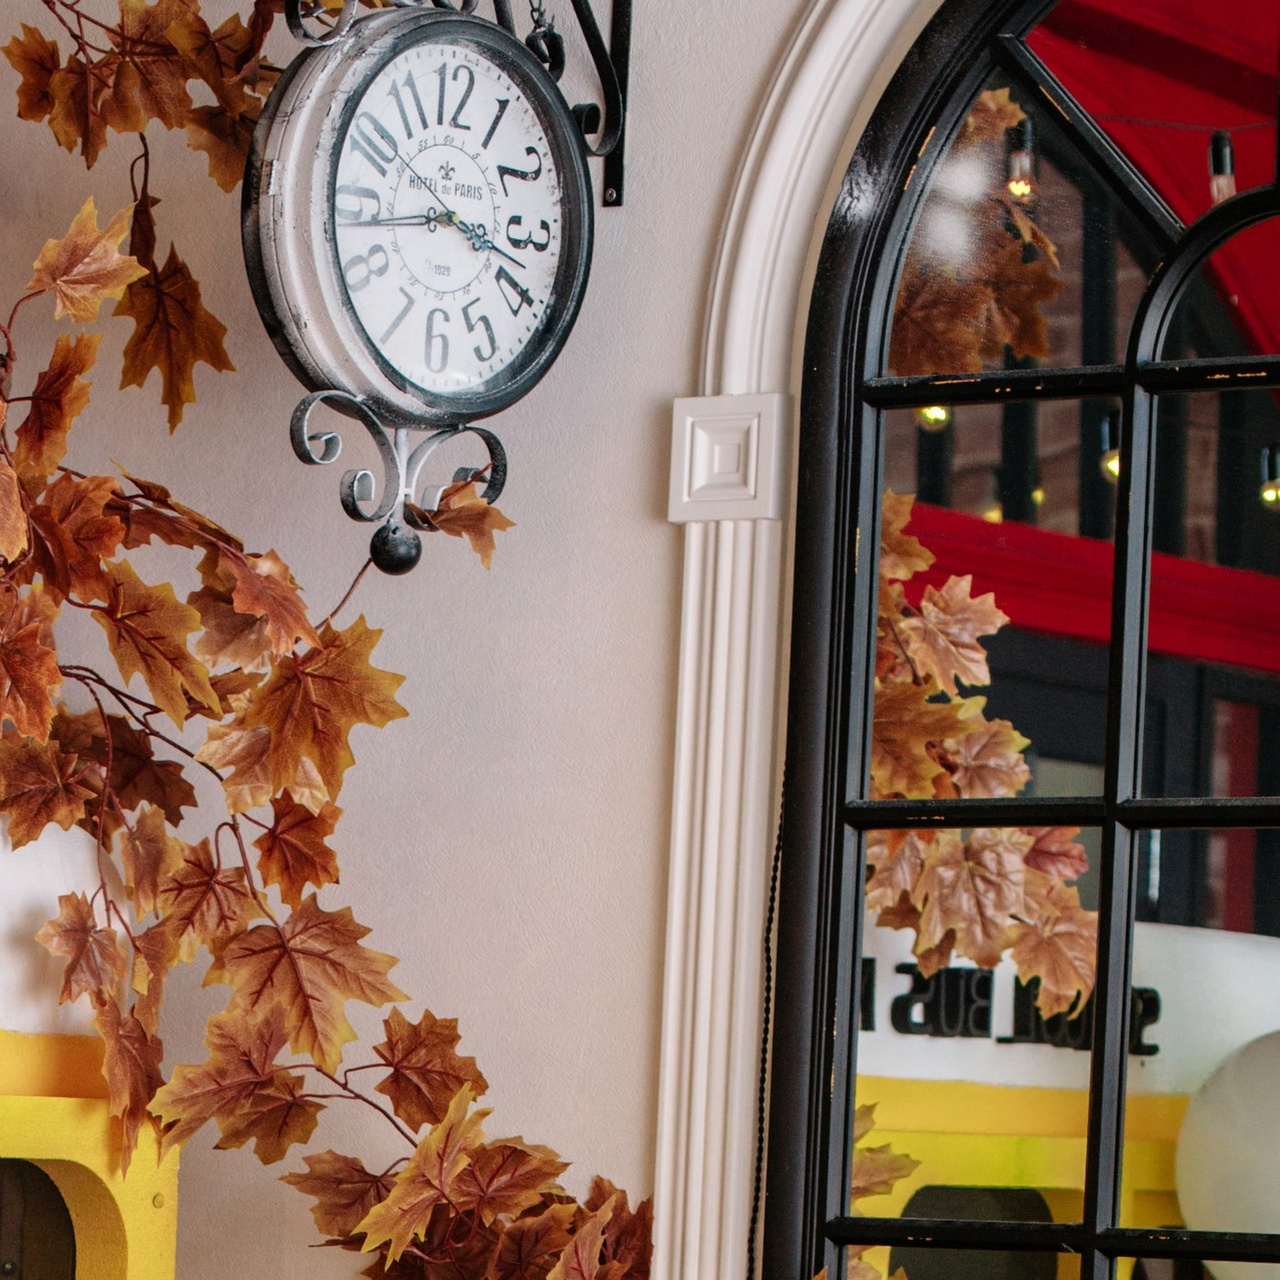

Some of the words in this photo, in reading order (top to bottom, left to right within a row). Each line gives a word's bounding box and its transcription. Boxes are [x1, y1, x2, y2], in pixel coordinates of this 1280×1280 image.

[386, 69, 428, 140] 11
[433, 61, 475, 131] 12
[349, 111, 398, 178] 10
[481, 97, 510, 150] 1
[409, 175, 438, 194] HOTEL
[454, 182, 483, 201] PARIS
[496, 146, 542, 197] 2
[335, 184, 381, 222] 9
[506, 215, 550, 252] 3
[343, 243, 390, 293] 8
[494, 265, 535, 317] 4
[379, 286, 415, 345] 7
[424, 307, 450, 374] 6
[461, 297, 496, 362] 5
